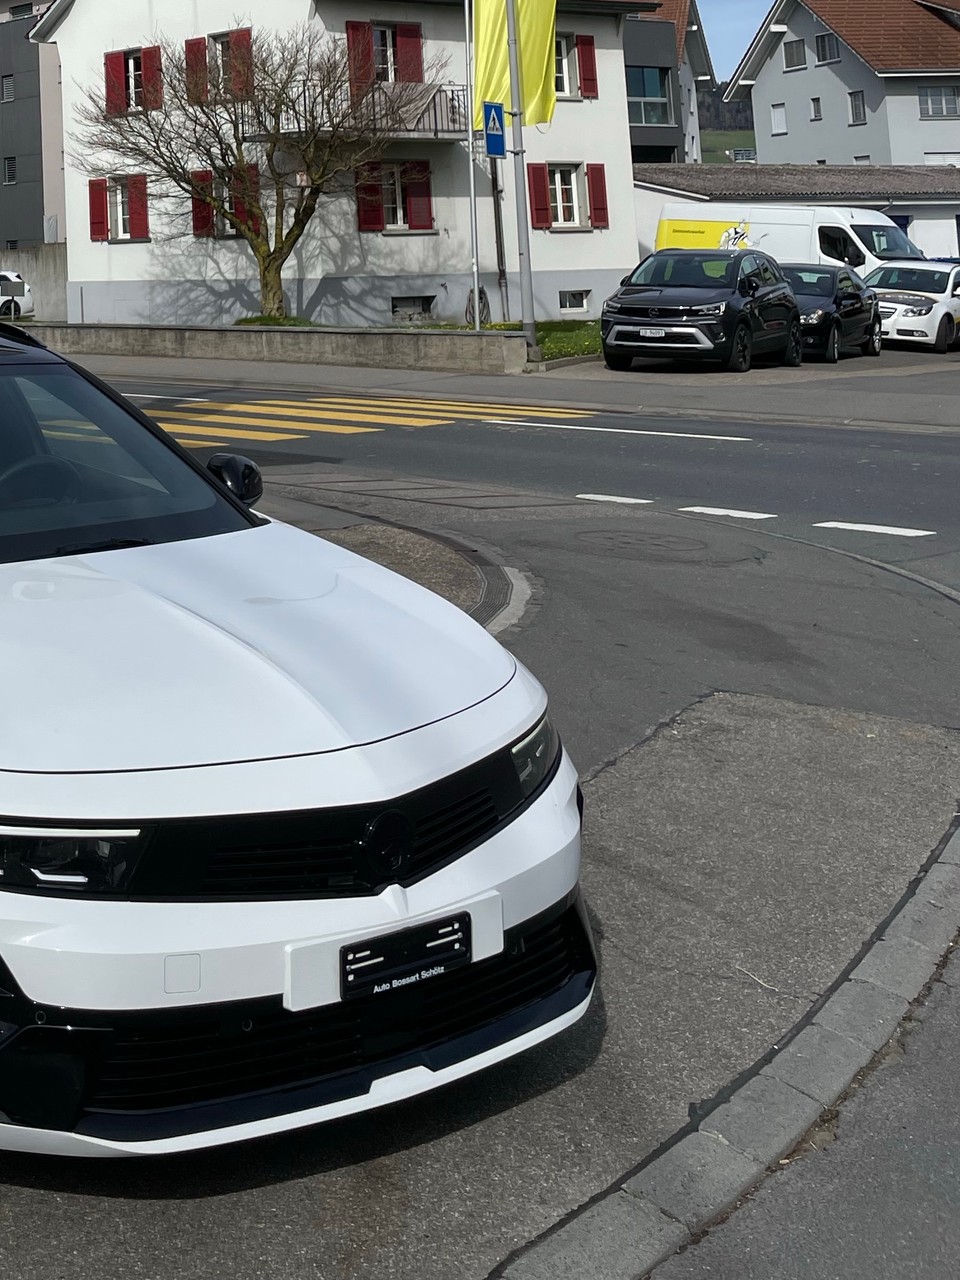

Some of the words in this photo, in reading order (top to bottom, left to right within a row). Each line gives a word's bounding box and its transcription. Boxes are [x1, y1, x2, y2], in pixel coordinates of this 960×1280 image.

[373, 985, 391, 994] Auto
[392, 973, 420, 988] Bossart
[421, 966, 445, 980] Schötz
